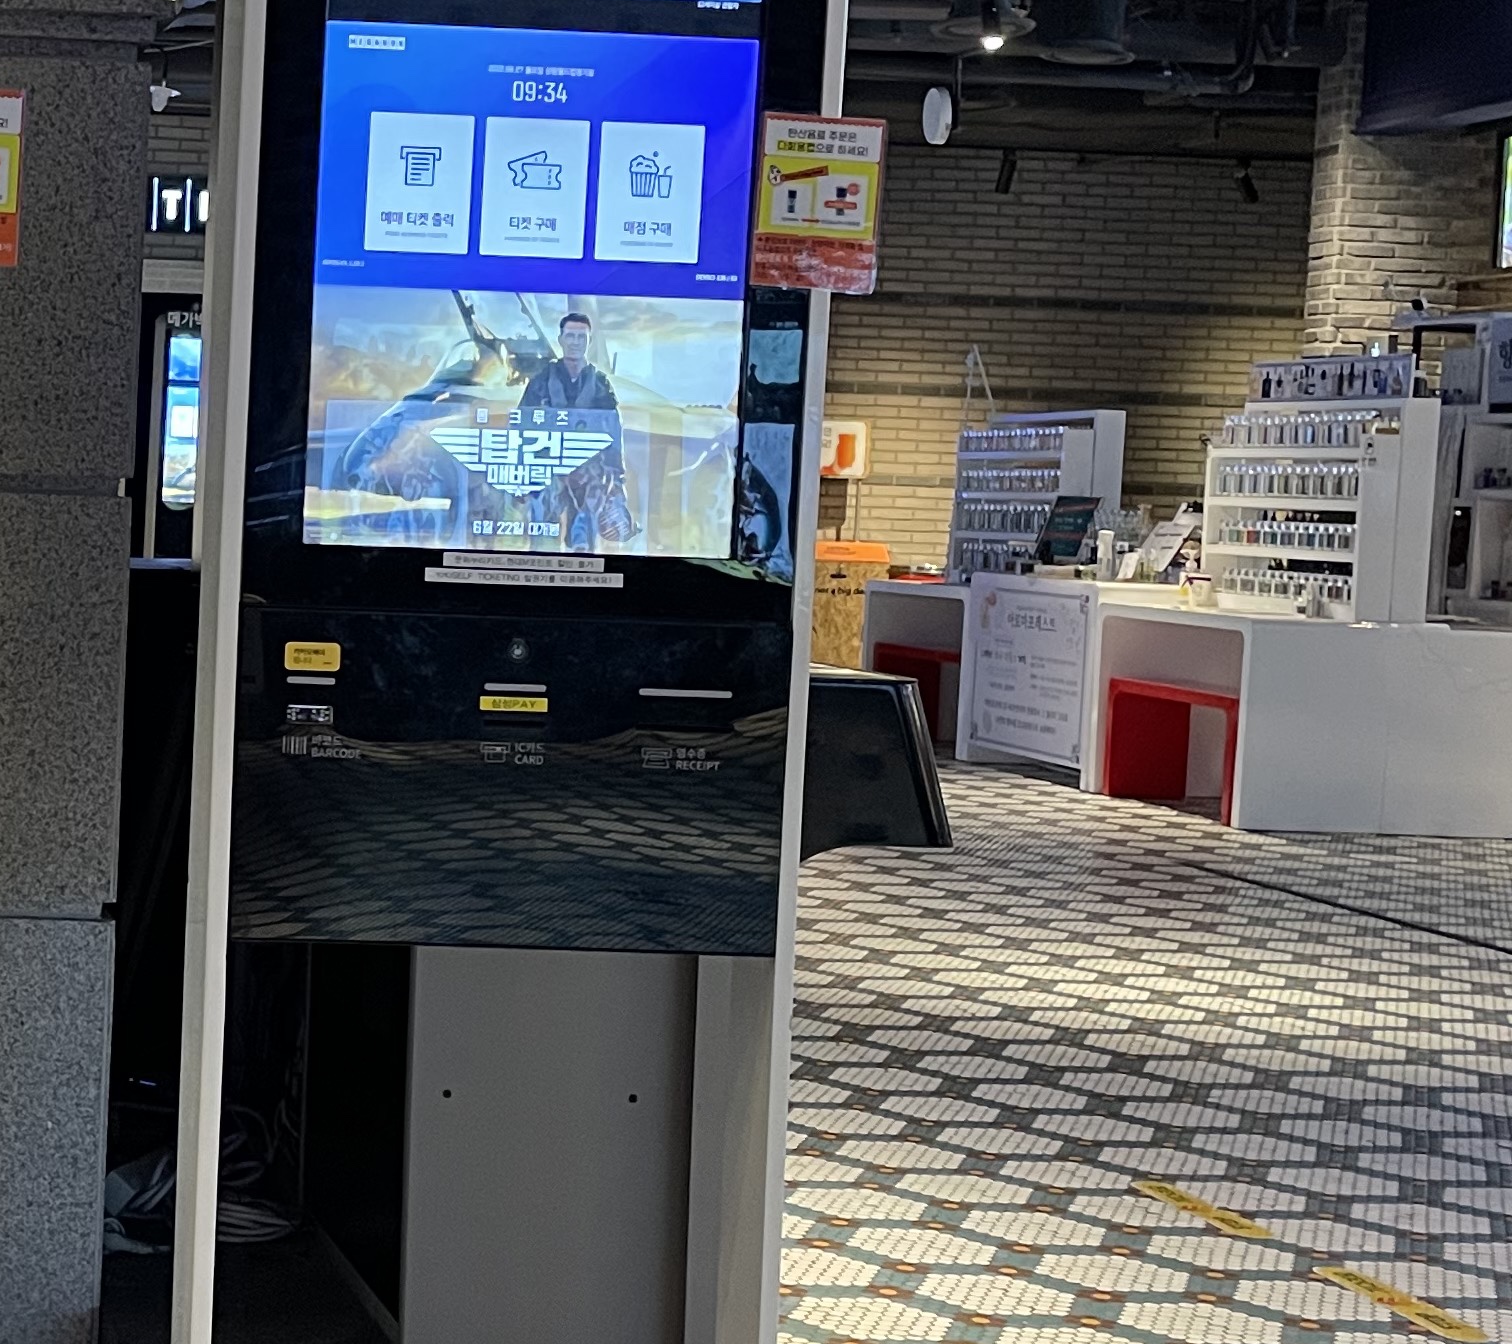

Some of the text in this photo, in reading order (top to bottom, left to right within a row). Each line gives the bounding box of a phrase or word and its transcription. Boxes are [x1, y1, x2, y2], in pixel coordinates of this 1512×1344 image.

[512, 80, 567, 103] 09:34
[406, 211, 429, 226] 티켓
[509, 217, 532, 231] 티켓
[481, 428, 562, 465] 탑건
[487, 464, 552, 486] 매버릭
[473, 520, 494, 534] 6월
[496, 521, 524, 535] 22일
[311, 747, 362, 759] BARCODE
[514, 754, 544, 765] CARD
[675, 760, 720, 771] RECEIPT
